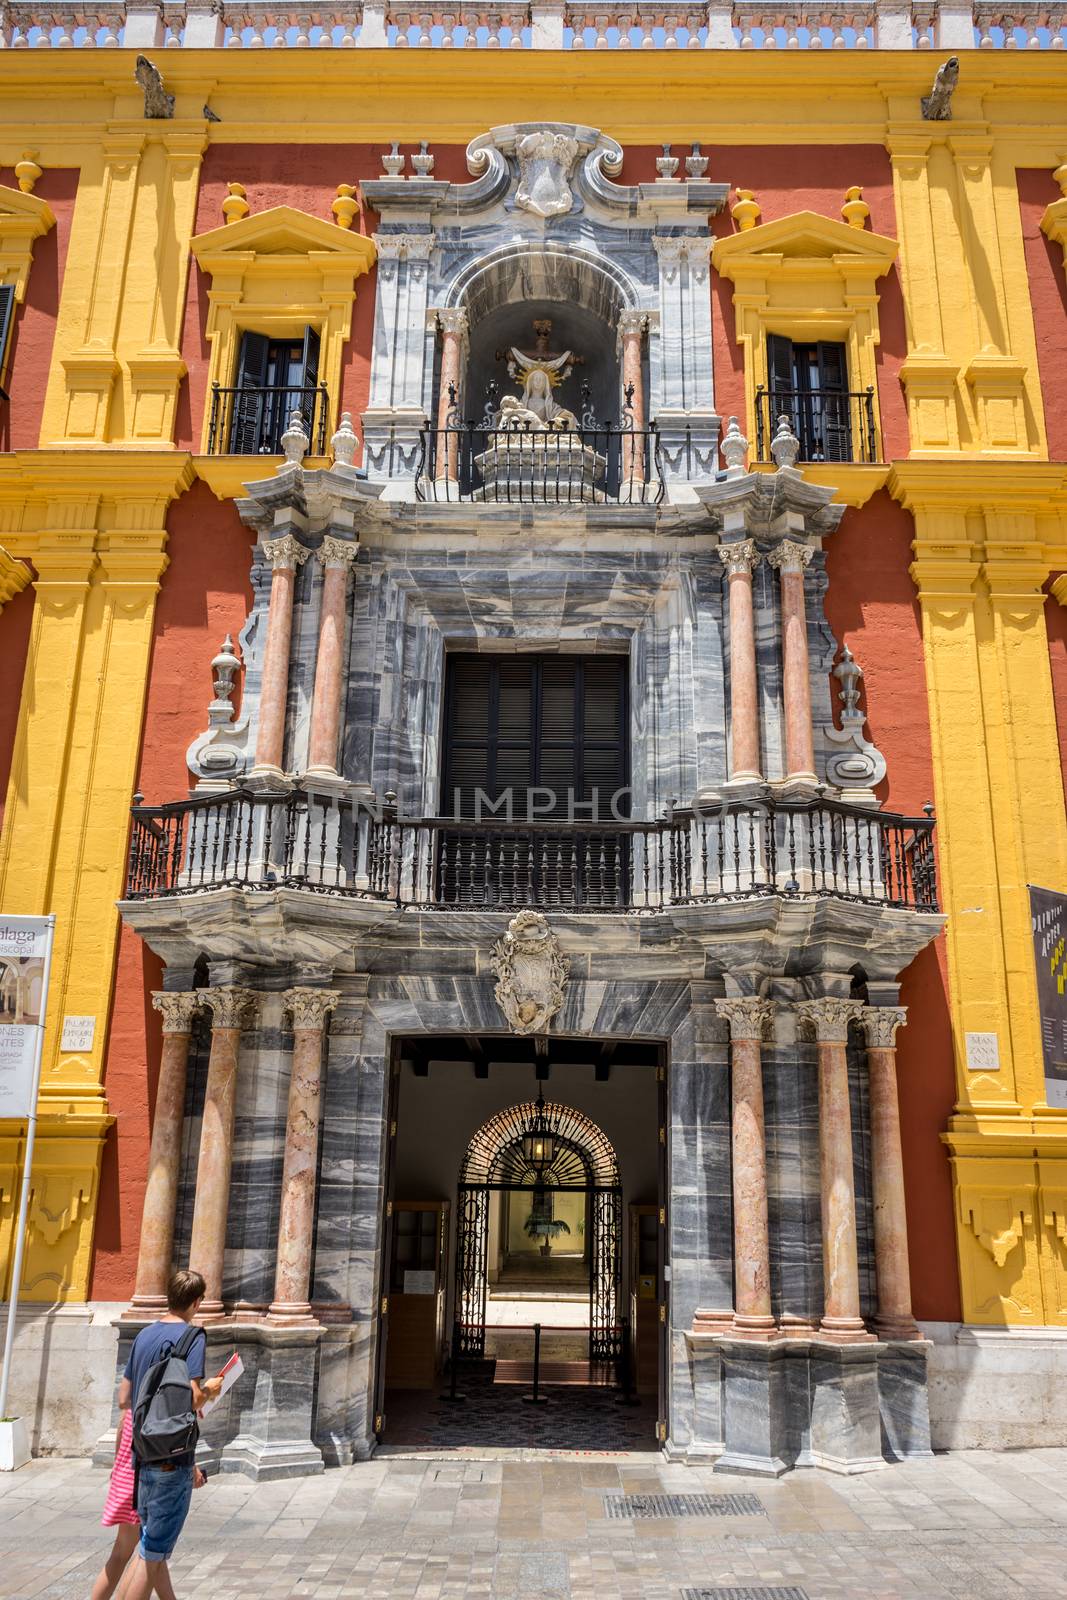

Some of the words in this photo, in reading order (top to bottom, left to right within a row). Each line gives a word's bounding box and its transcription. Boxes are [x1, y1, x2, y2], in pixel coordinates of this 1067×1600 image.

[1042, 922, 1060, 957] AFTER
[0, 944, 35, 955] iscopal
[548, 1450, 631, 1458] ENTRADA
